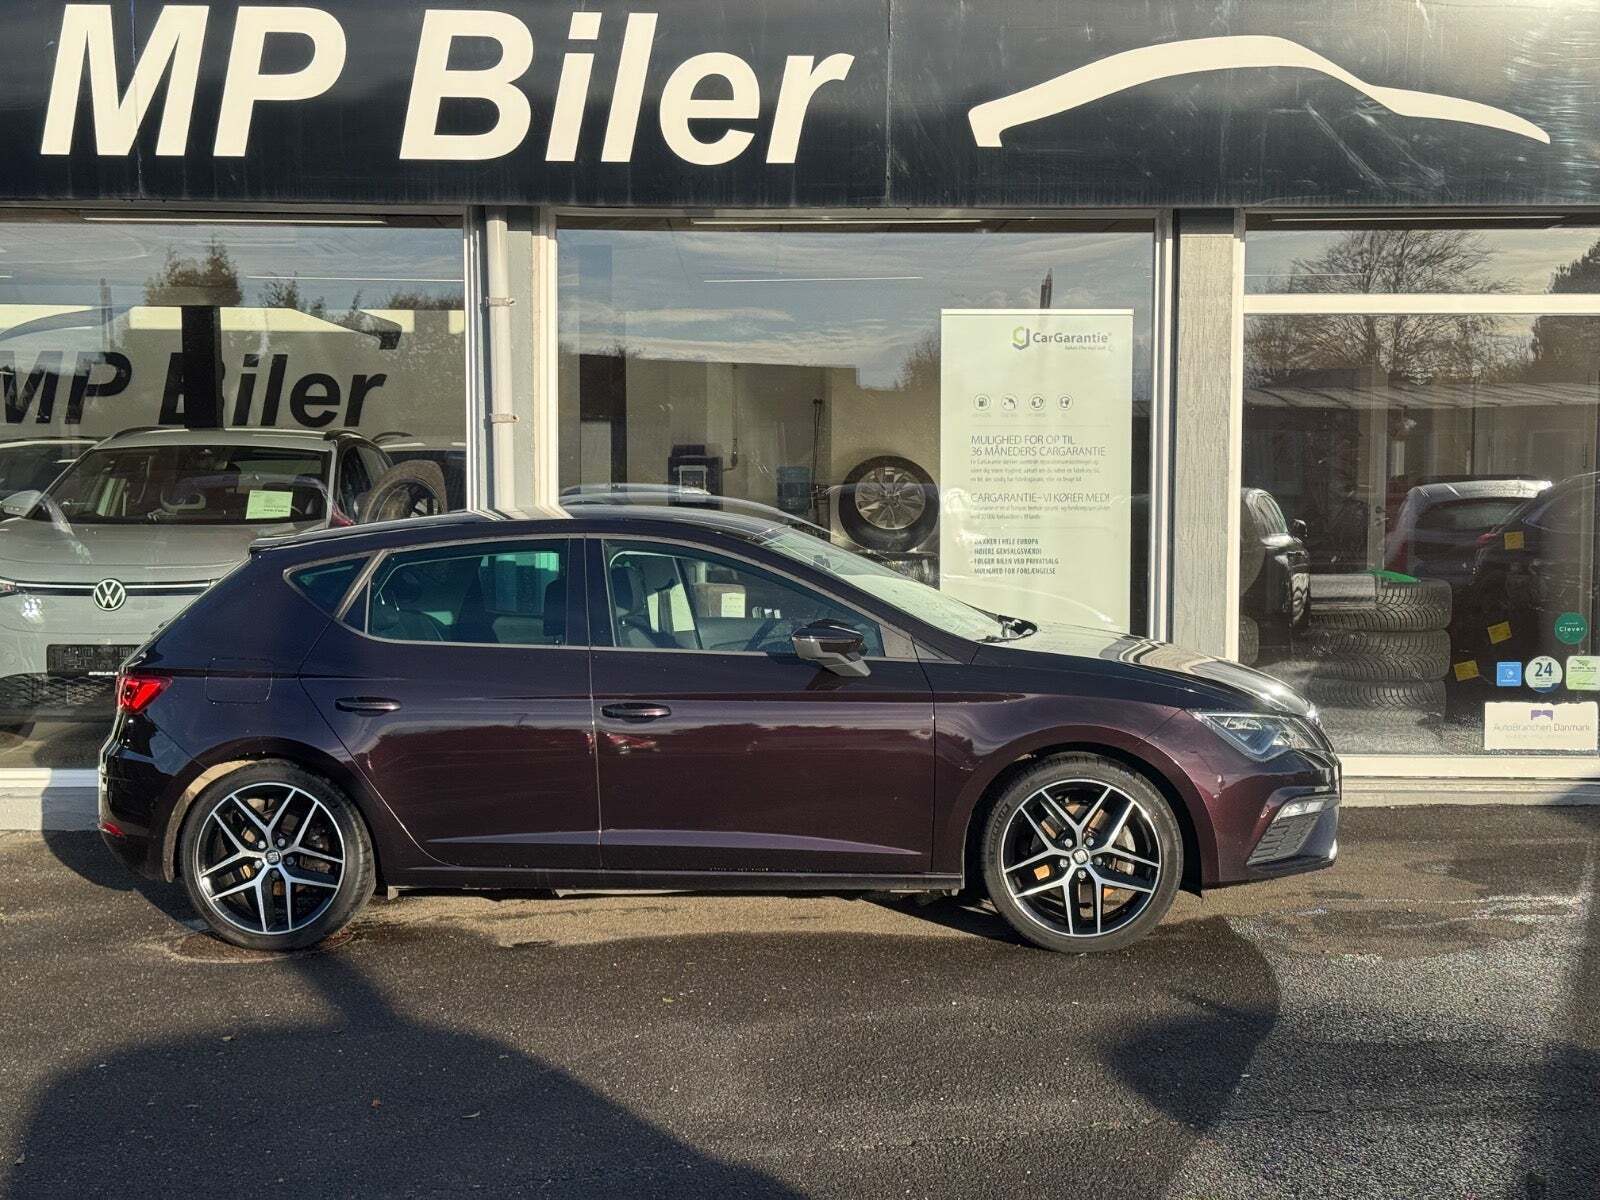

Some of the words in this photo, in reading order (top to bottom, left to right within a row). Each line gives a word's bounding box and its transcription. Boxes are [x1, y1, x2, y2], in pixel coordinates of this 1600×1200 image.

[40, 4, 347, 158] MP
[399, 10, 855, 165] Biler
[1032, 332, 1109, 344] CarGarantie
[0, 350, 133, 425] MP
[1024, 435, 1044, 445] FOR
[1535, 662, 1553, 677] 24
